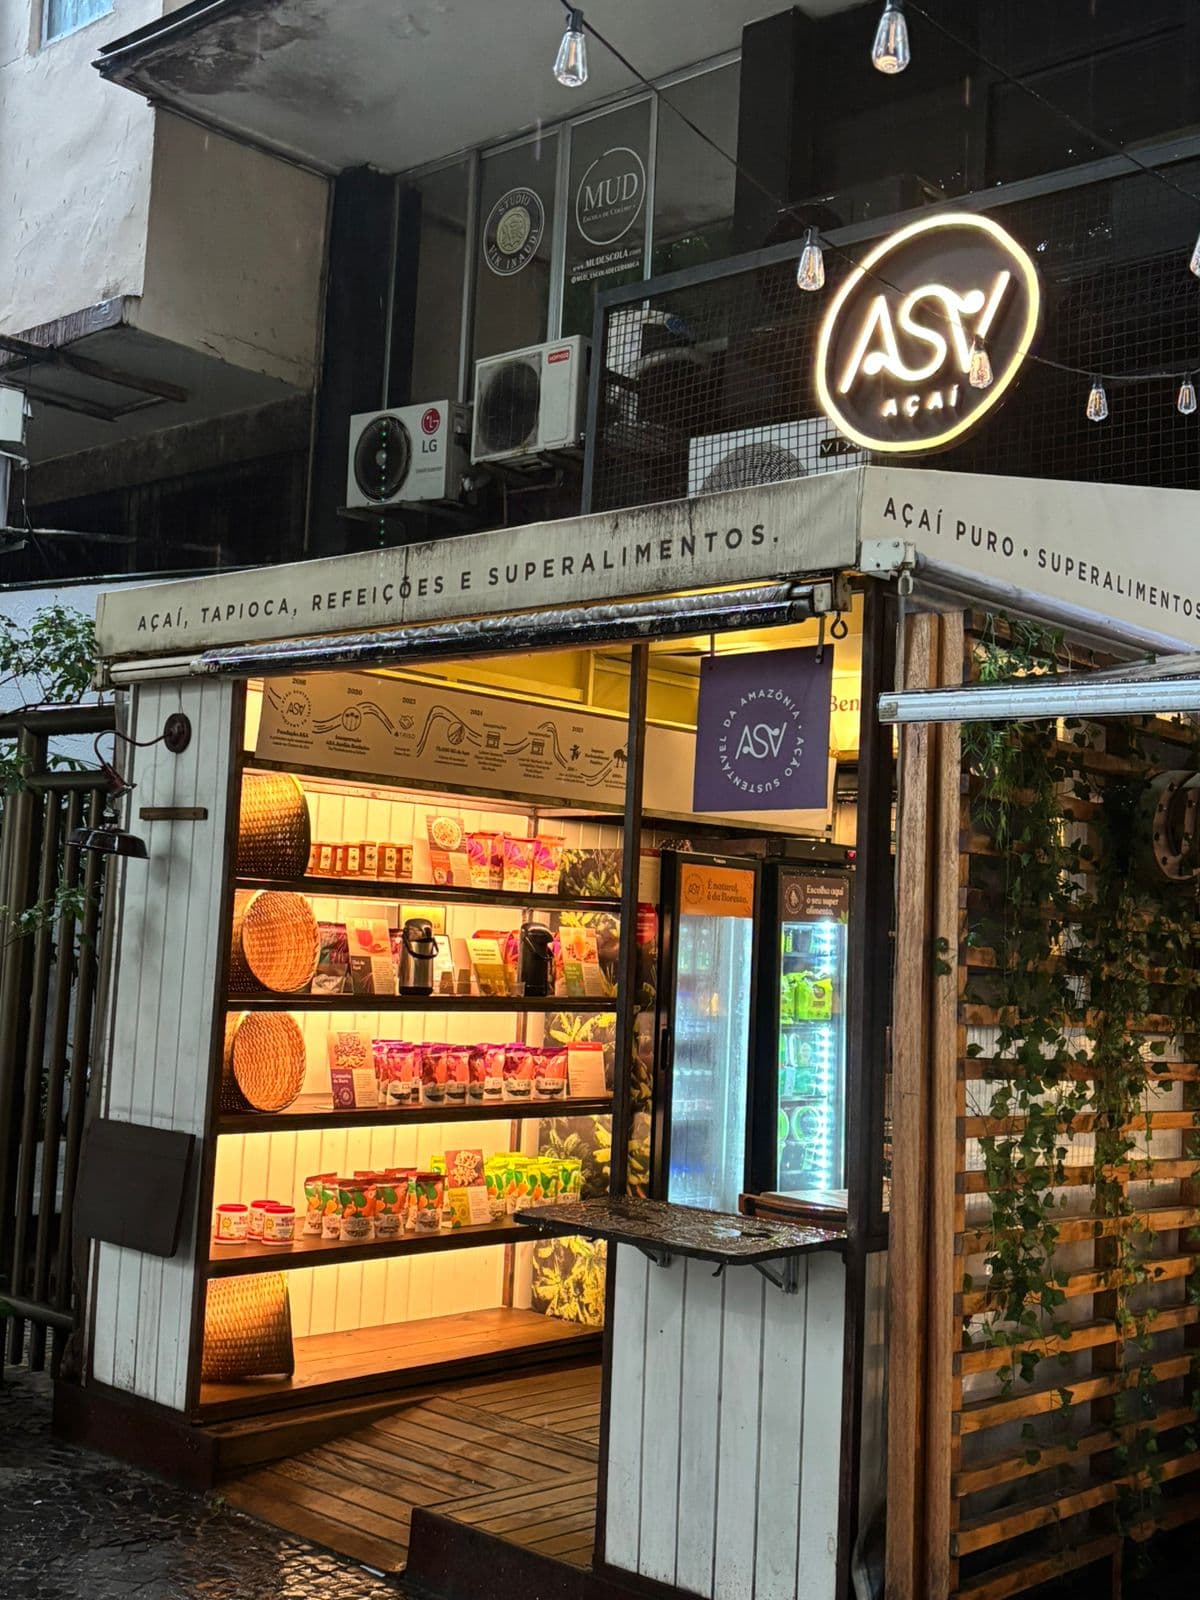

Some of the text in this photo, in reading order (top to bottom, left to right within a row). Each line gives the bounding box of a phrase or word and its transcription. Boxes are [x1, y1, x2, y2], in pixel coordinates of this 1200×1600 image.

[584, 172, 638, 211] MUD
[422, 439, 437, 453] LG
[137, 525, 779, 632] AÇAÍ, TAPIOCA, REFEIÇÕES E SUPERALIMENTOS.
[882, 497, 1200, 621] AÇAÍ PURO SUPERALIMENTOS
[719, 688, 805, 794] AÇÃO SUSTENTÁVEL DA AMAZÔNIA
